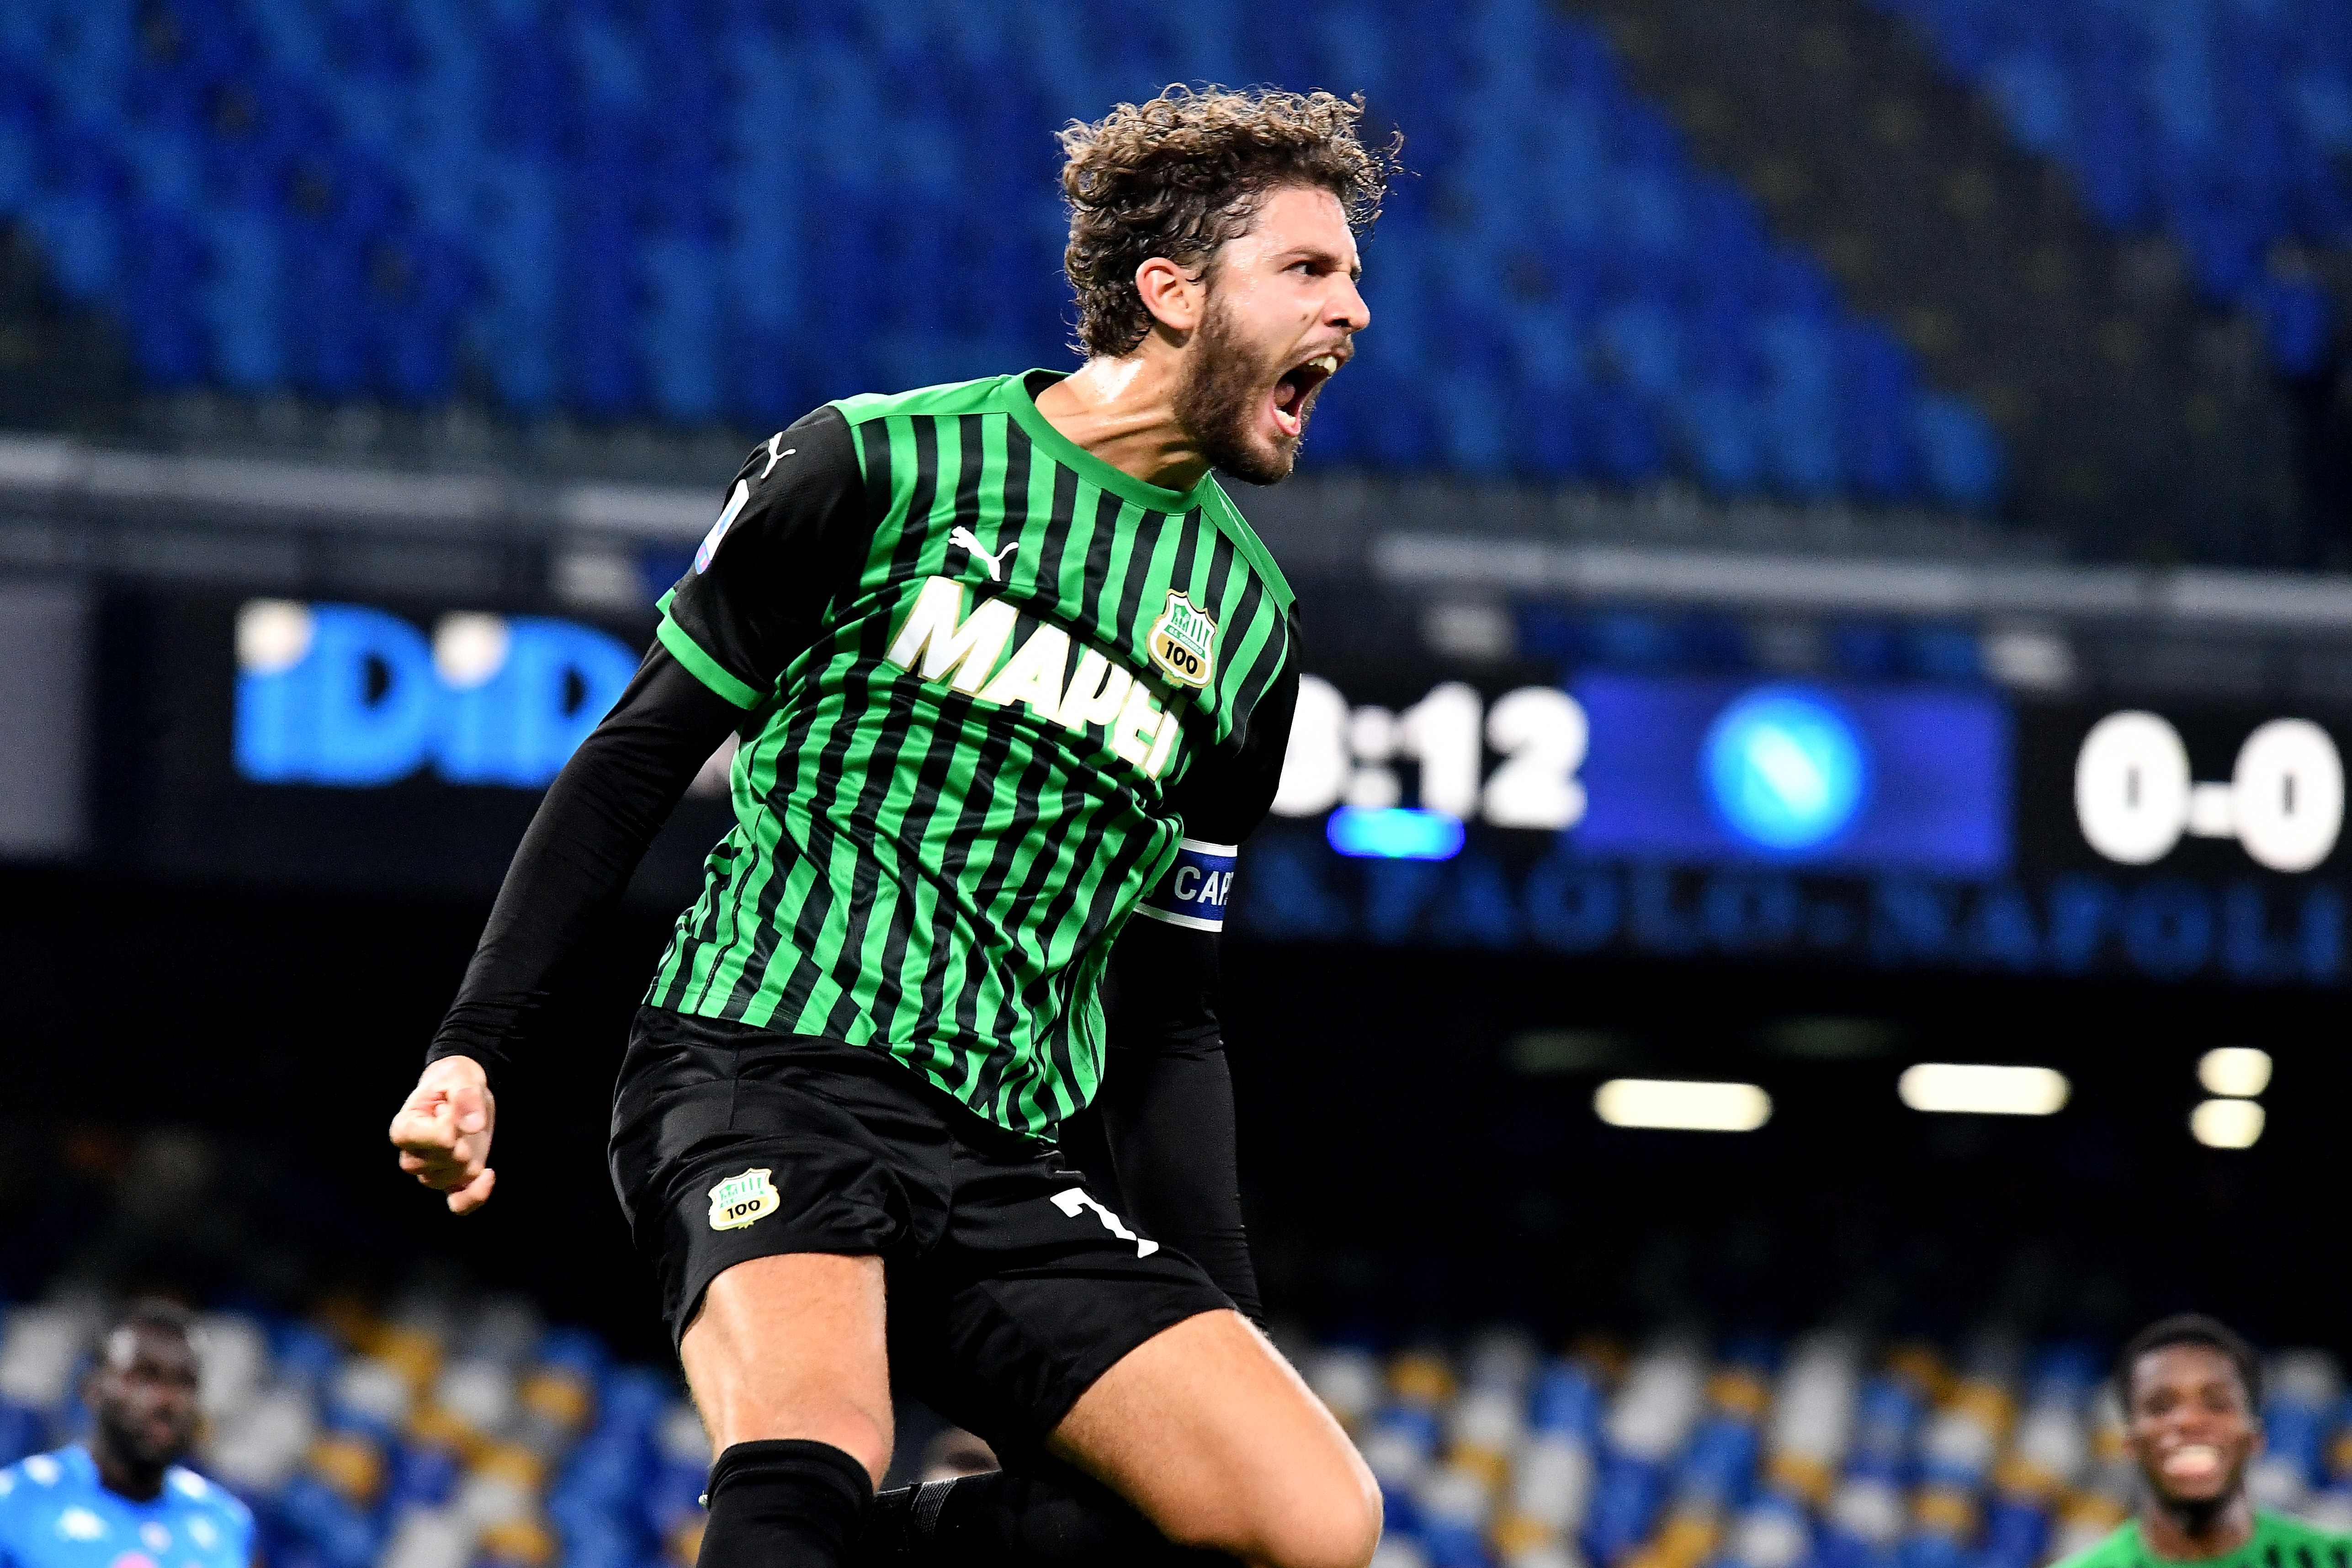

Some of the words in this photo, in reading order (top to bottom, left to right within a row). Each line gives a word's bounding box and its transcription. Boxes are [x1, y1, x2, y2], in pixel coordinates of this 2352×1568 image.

[884, 575, 1184, 782] MAPEI
[1165, 640, 1198, 675] 100
[2074, 709, 2346, 874] 0-0
[727, 1200, 760, 1219] 100
